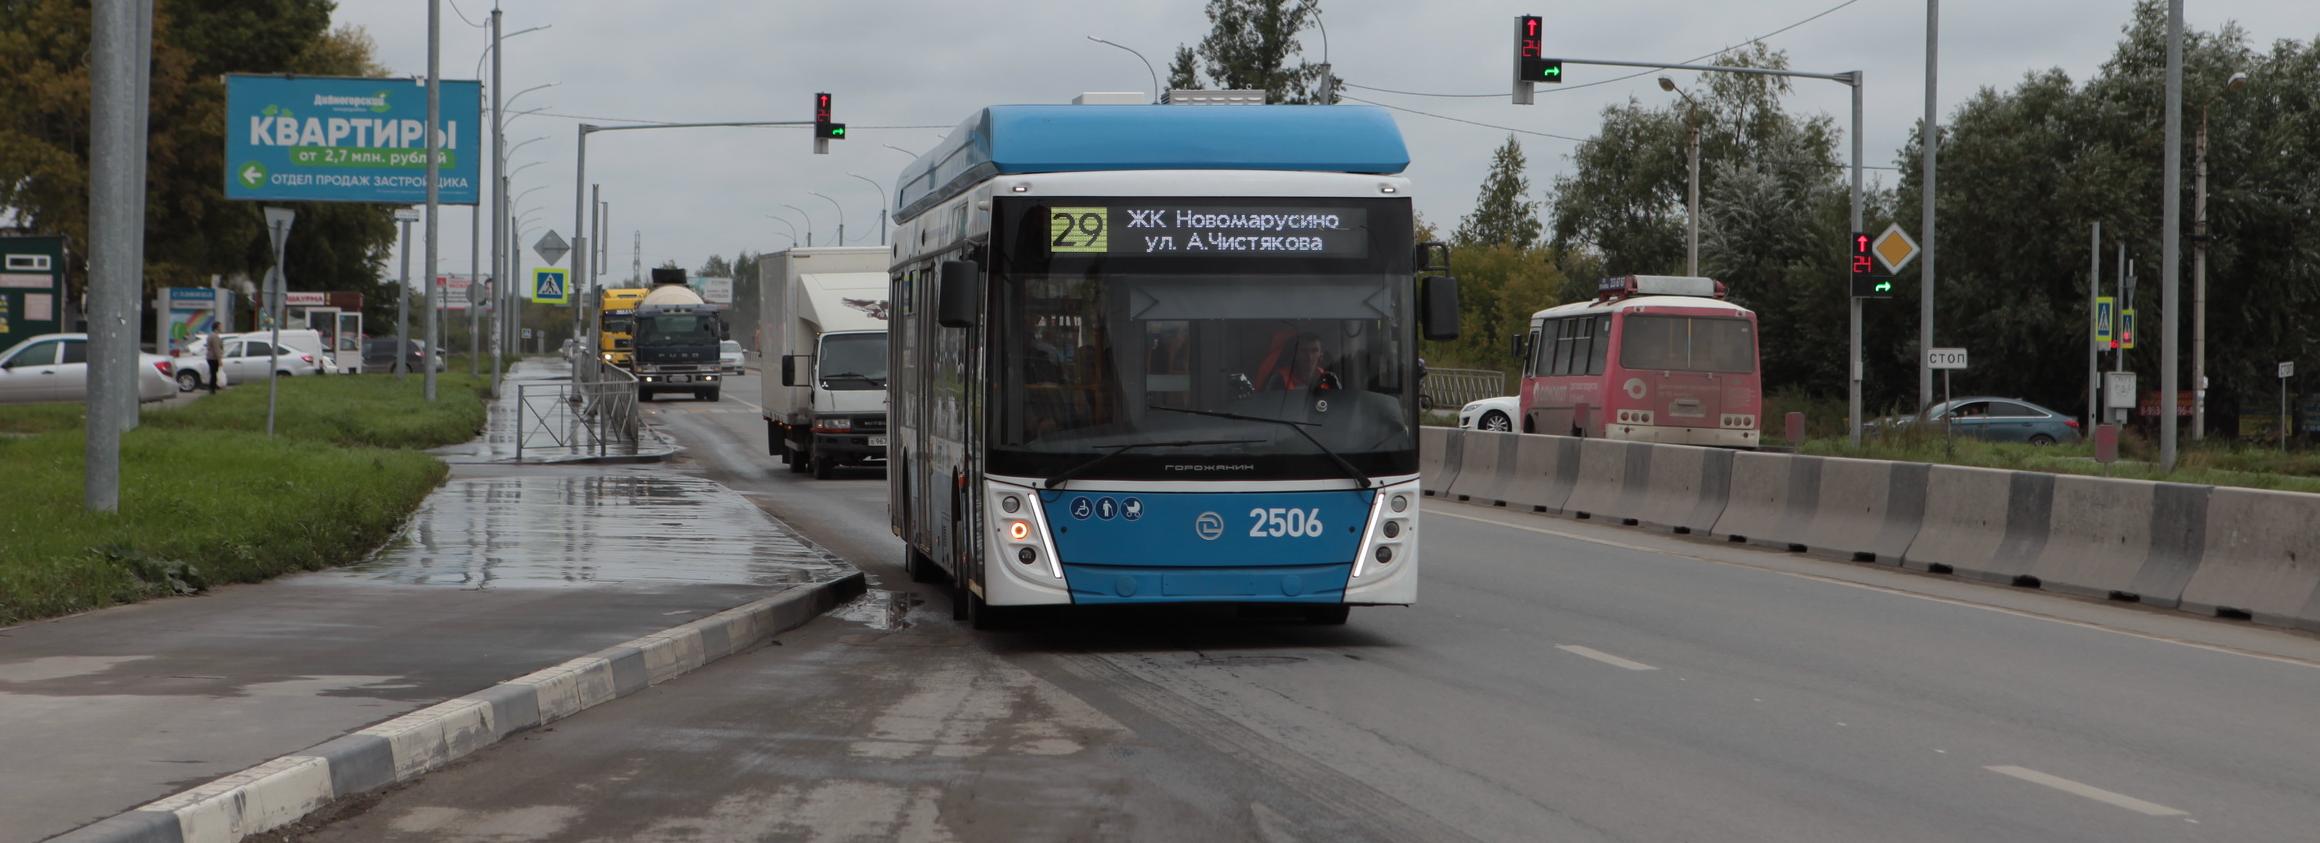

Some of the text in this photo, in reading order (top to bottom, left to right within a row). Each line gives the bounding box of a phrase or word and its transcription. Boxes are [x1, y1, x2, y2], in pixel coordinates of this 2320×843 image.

[1522, 39, 1540, 57] 24
[250, 115, 457, 150] КВАРТИРЫ
[299, 149, 448, 167] от 2,7 млн. рублй
[271, 173, 313, 186] ОТДЕЛ
[316, 174, 370, 188] ПРОДАЖ
[1052, 212, 1105, 247] 29
[1126, 209, 1340, 234] ЖК Новомарусино
[1145, 233, 1324, 253] ул. А.Чистякова
[1852, 254, 1872, 273] 24
[1929, 352, 1966, 364] СТОП
[1164, 463, 1255, 472] ГОРОЖАНИН
[1248, 507, 1324, 539] 2506
